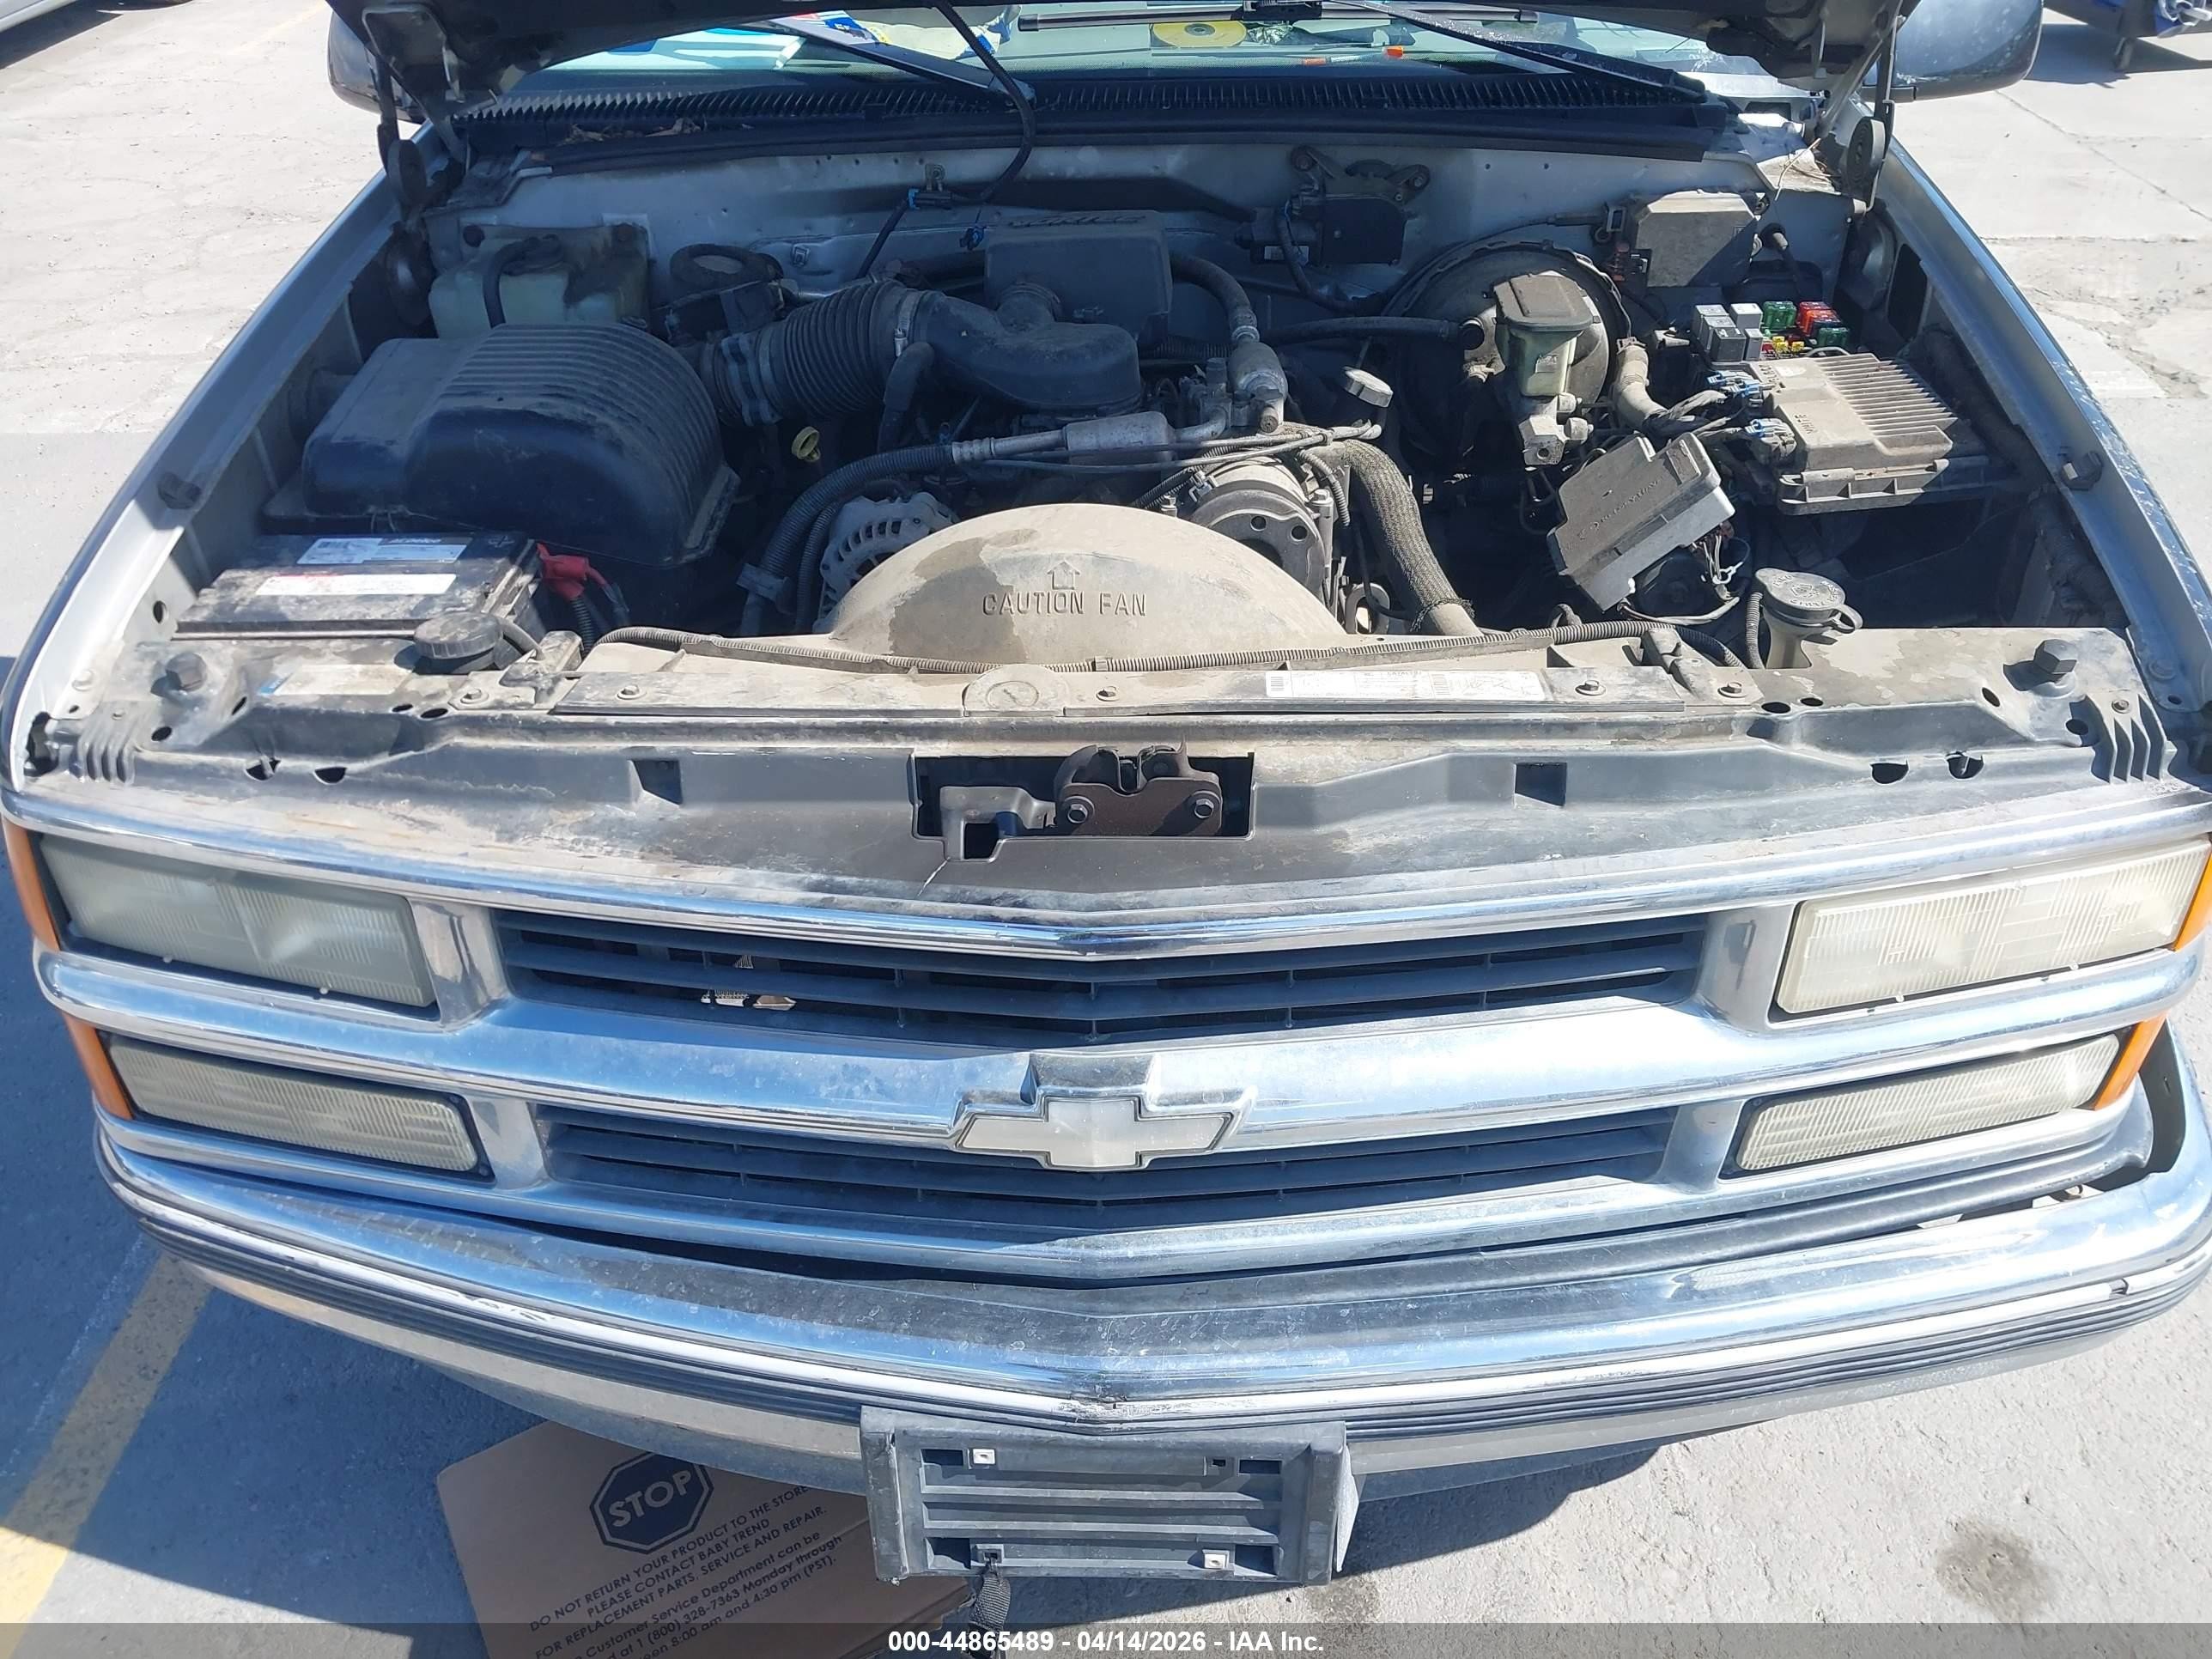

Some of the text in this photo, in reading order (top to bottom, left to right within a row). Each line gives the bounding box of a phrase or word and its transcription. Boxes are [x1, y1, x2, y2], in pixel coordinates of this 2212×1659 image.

[982, 591, 1146, 616] CAUTION FAN
[609, 1470, 691, 1528] STOP
[530, 1615, 551, 1632] DO
[555, 1598, 581, 1620] NOT
[585, 1574, 631, 1603] RETURN
[633, 1555, 668, 1577] YOUR
[672, 1523, 728, 1559] PRODUCT
[731, 1515, 747, 1528] TO
[749, 1503, 771, 1519] THE
[535, 1641, 563, 1659] FOR
[565, 1593, 654, 1646] REPLACEMENT
[701, 1545, 751, 1576] SERVICE
[755, 1528, 781, 1547] AND
[783, 1505, 827, 1533] REPAIR.
[586, 1623, 648, 1656] Customer
[652, 1595, 698, 1625] Service
[702, 1553, 776, 1598] Department
[778, 1541, 802, 1559] can
[803, 1531, 820, 1545] be
[587, 1518, 769, 1618] PLEASE CONTACT BABY TREND
[620, 1644, 633, 1657] at
[647, 1622, 682, 1644] (800)
[683, 1589, 740, 1625] 328-7363
[743, 1560, 793, 1593] Monday
[795, 1534, 842, 1565] through
[672, 1555, 836, 1647] 8:00 am and 4:30 pm (PST).
